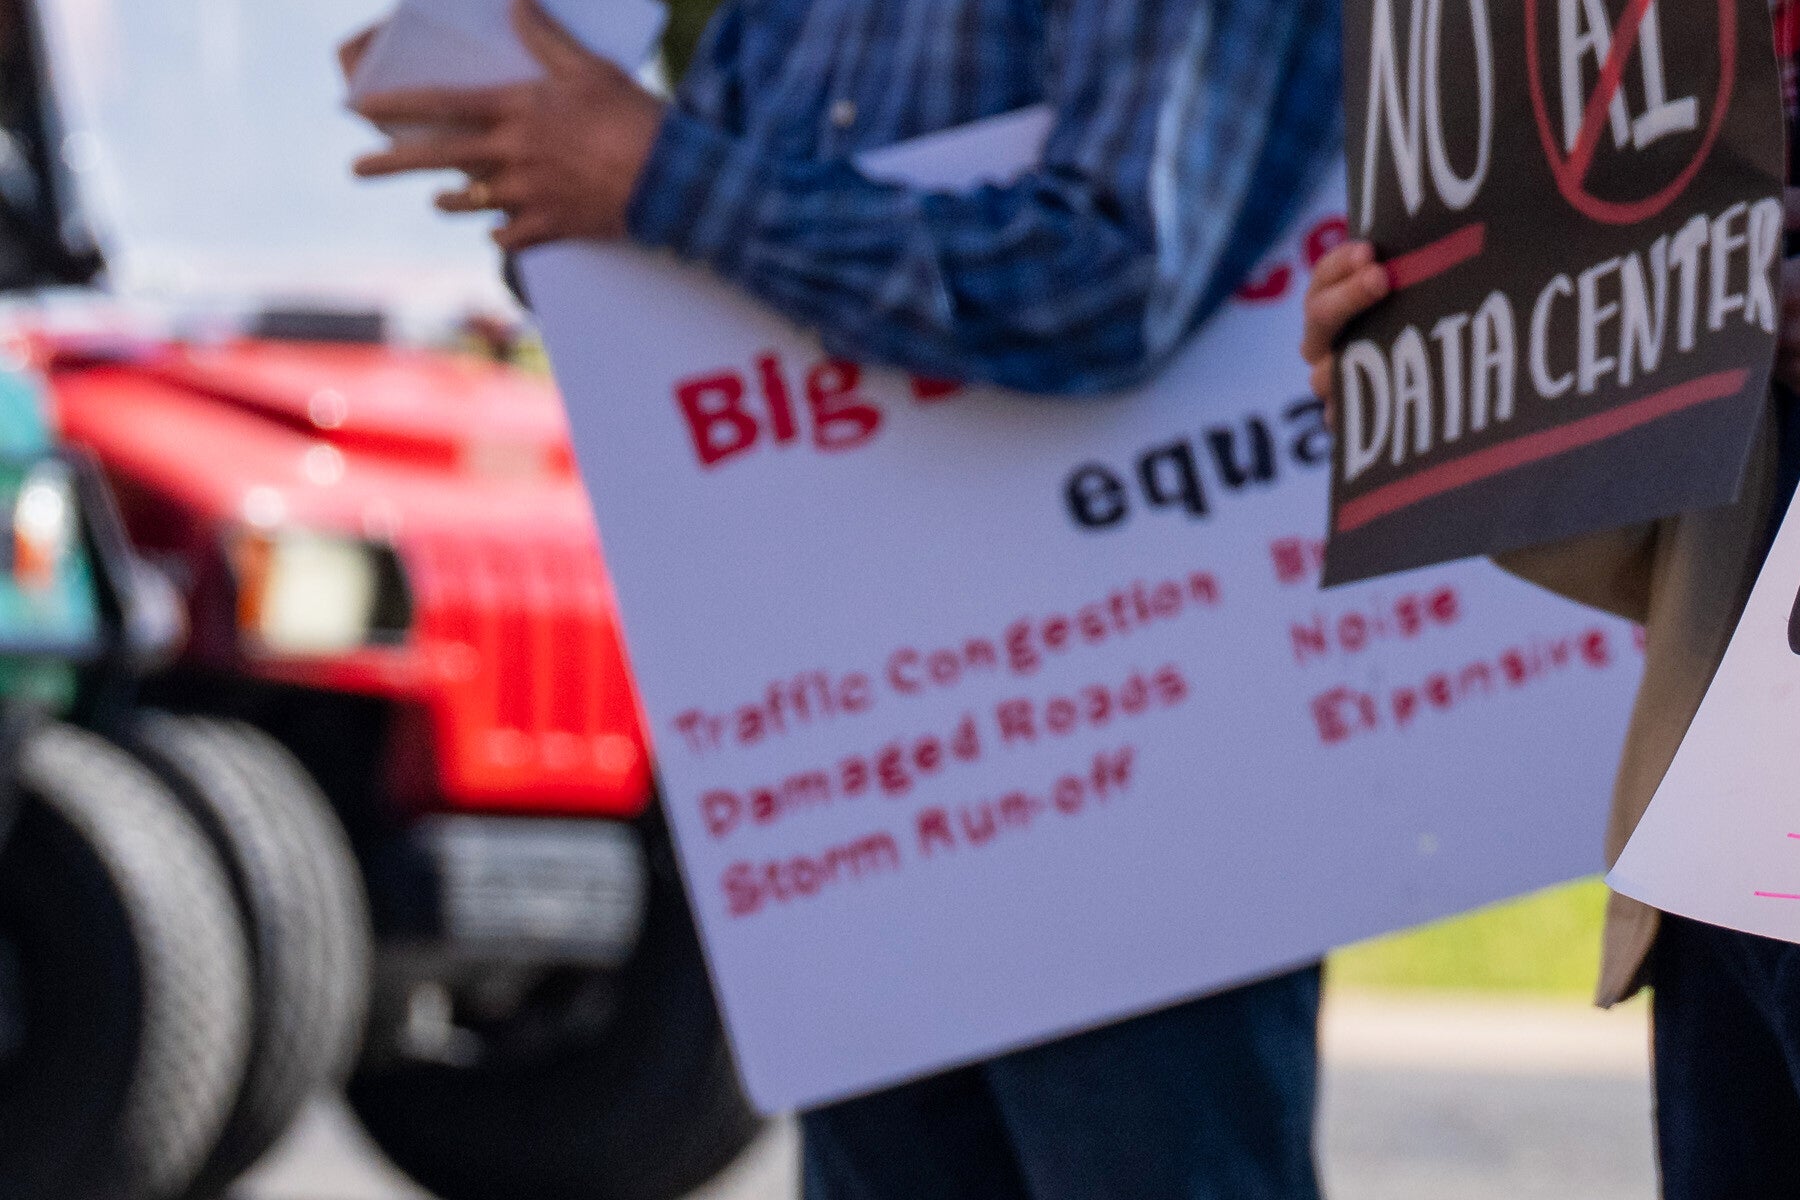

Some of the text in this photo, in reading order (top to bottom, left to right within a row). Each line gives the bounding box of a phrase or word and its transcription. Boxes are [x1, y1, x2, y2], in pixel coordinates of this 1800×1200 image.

[1342, 288, 1518, 484] DATA
[1528, 196, 1783, 399] CENTER
[1062, 396, 1335, 533] equa
[672, 569, 1221, 753] Traffic Congestion
[1289, 584, 1461, 668] Noise
[1310, 627, 1611, 746] Expensive
[700, 663, 1189, 839] Damaged Roads
[720, 832, 900, 919] Storm
